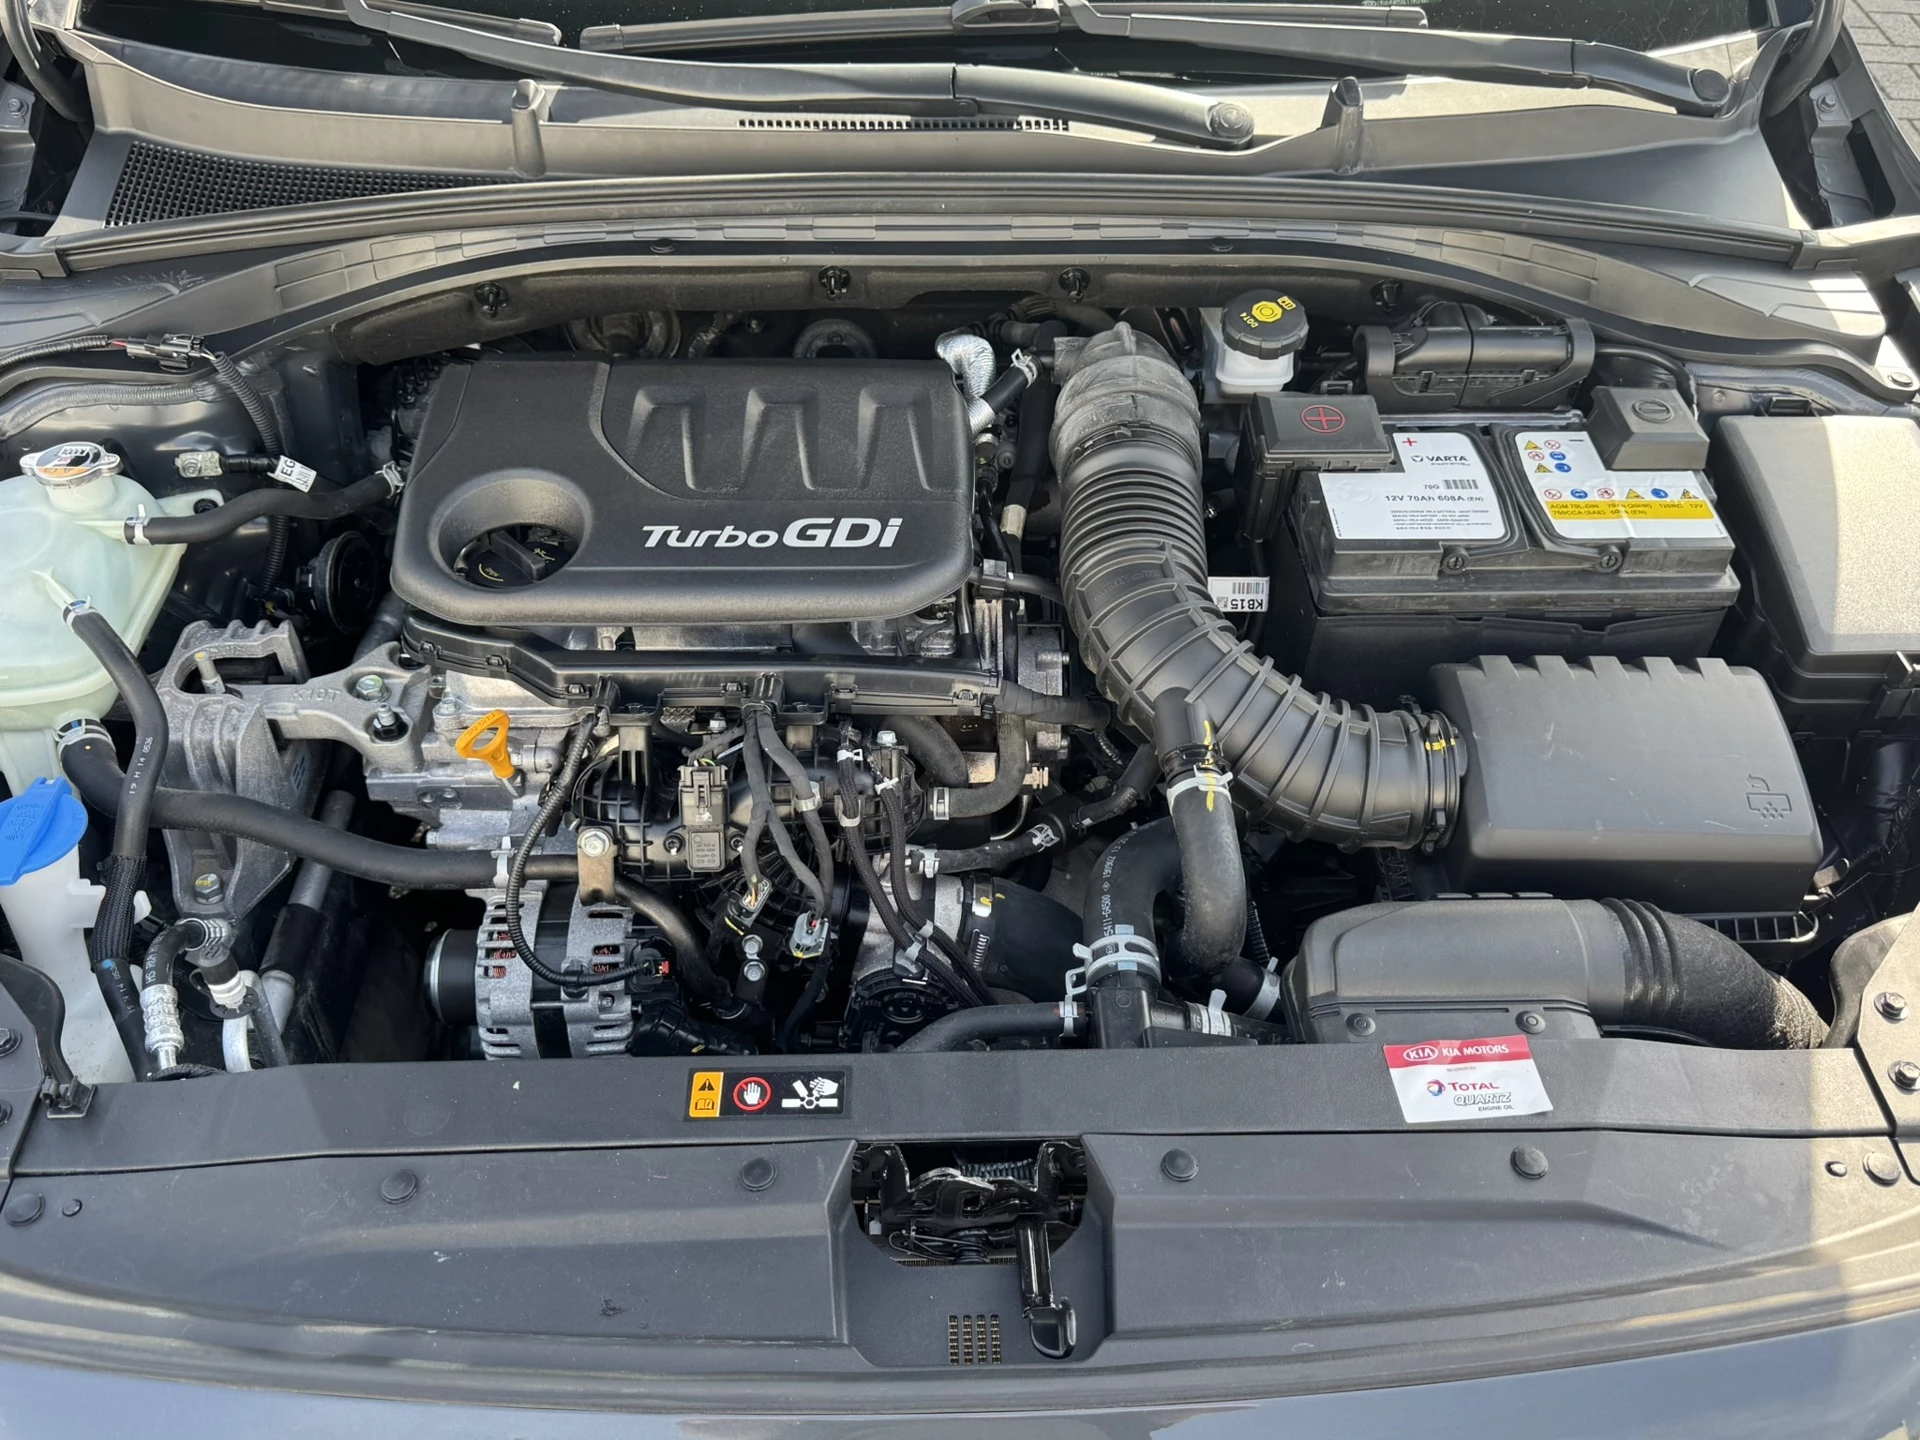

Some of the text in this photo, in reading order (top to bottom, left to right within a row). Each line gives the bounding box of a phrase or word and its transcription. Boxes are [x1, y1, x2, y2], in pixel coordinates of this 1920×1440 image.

[1240, 312, 1259, 328] DOT4
[1230, 598, 1264, 610] KB15
[1442, 1048, 1462, 1057] KIA
[1464, 1044, 1509, 1056] MOTORS
[1454, 1092, 1512, 1107] QUARTZ
